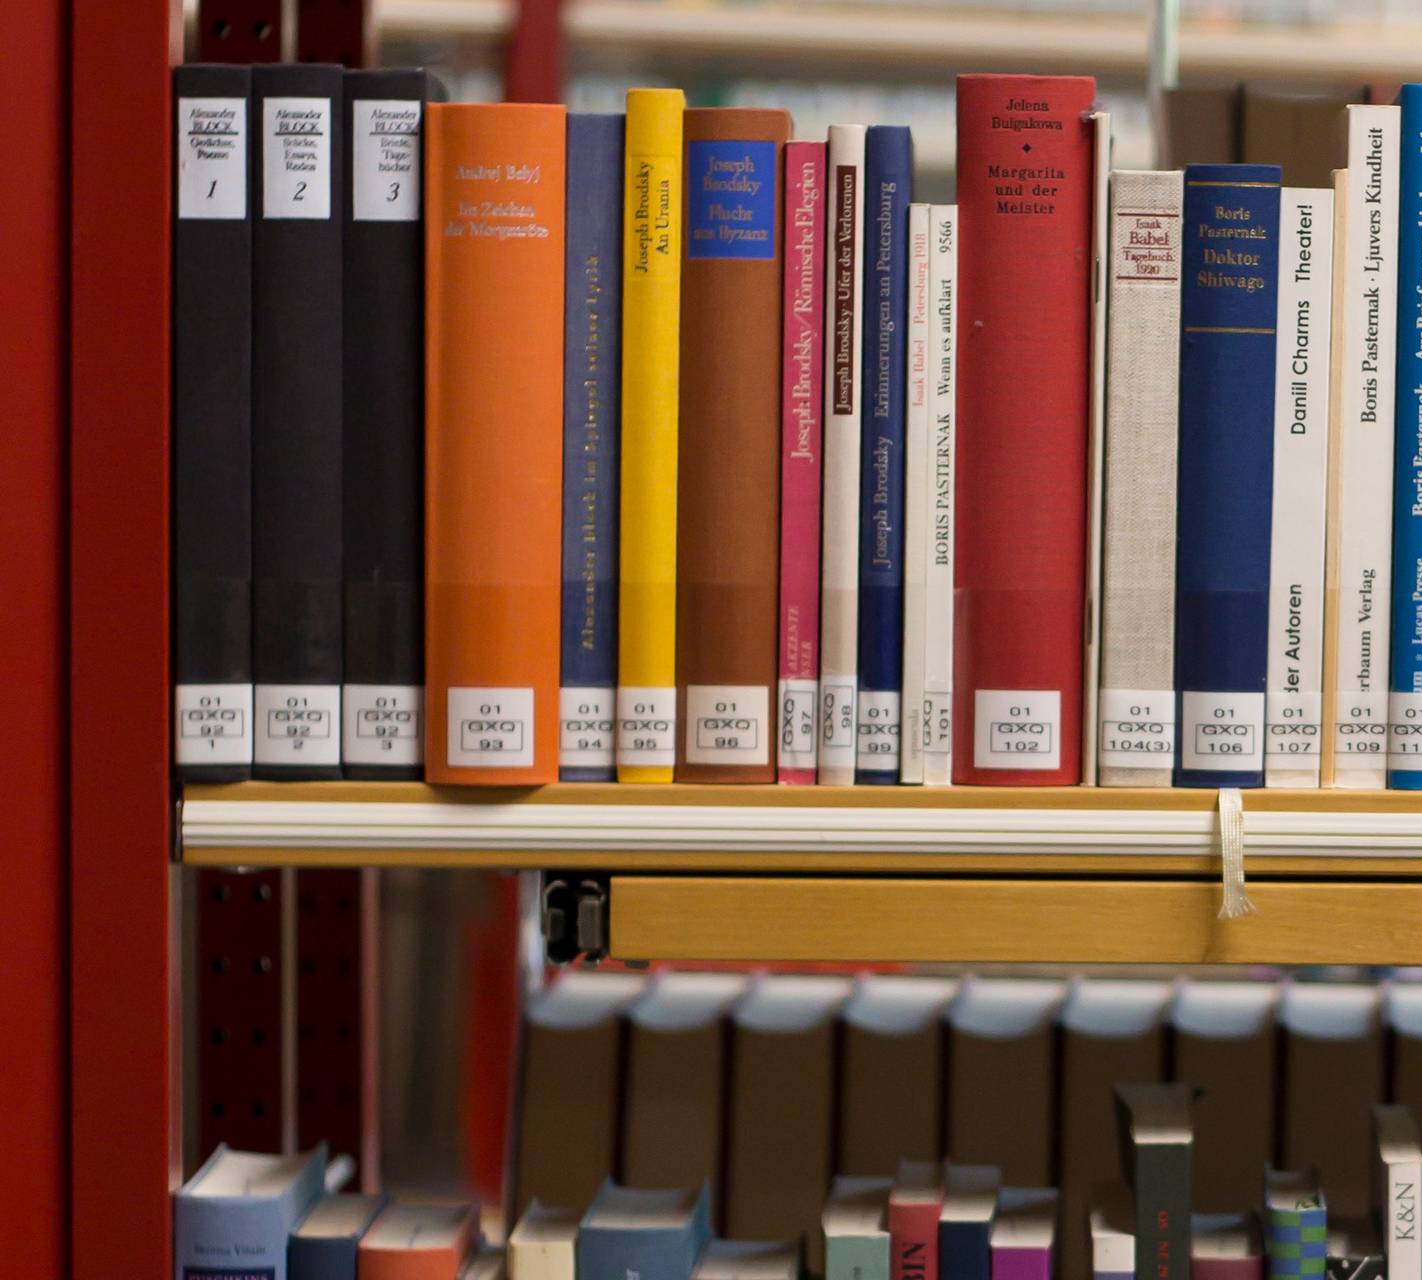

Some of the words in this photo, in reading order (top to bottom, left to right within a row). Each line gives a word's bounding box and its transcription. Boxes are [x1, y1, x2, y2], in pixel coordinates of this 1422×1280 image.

[1006, 99, 1049, 112] Jelena
[991, 117, 1063, 131] Bulgakowa
[707, 156, 754, 175] Joseph
[988, 165, 1065, 182] Margarita
[1365, 128, 1382, 204] Kindheit
[293, 182, 306, 201] 2
[386, 182, 400, 202] 3
[635, 161, 655, 220] Brodsky
[703, 176, 760, 196] Brodsky
[795, 162, 818, 227] Elegien
[995, 184, 1026, 197] und
[1032, 184, 1057, 197] der
[656, 180, 669, 229] Urania
[839, 174, 852, 242] Verlorenen
[996, 201, 1055, 215] Meister
[1215, 206, 1250, 220] Boris
[876, 182, 896, 271] Petersburg
[939, 221, 953, 253] 9566
[1129, 231, 1170, 246] Babel
[1136, 218, 1161, 230] Isaak
[1199, 224, 1267, 239] Pasternak
[635, 223, 653, 273] Joseph
[656, 234, 669, 255] An
[838, 246, 851, 267] der
[1295, 205, 1312, 283] Theater!
[1364, 209, 1384, 273] Ljuvers
[1203, 249, 1260, 266] Doktor
[838, 269, 851, 300] Ufer
[878, 276, 890, 297] an
[1197, 271, 1264, 292] Shiwago
[837, 308, 852, 363] Brodsky
[1292, 300, 1309, 375] Charms
[1361, 288, 1379, 373] Pasternak
[875, 302, 895, 418] Erinnerungen
[836, 367, 851, 410] Joseph
[937, 357, 951, 396] Wenn
[1290, 382, 1307, 435] Daniil
[1361, 378, 1377, 424] Boris
[792, 401, 815, 463] Joseph
[874, 436, 893, 504] Brodsky
[935, 414, 951, 509] PASTERNAK
[874, 510, 892, 568] Joseph
[935, 514, 949, 565] BORIS
[1358, 569, 1375, 623] Verlag
[1284, 584, 1301, 661] Autoren
[479, 738, 503, 750] 93
[633, 738, 658, 750] 95
[714, 737, 739, 749] 96
[1003, 740, 1040, 752] 102
[1109, 740, 1171, 754] 104(3)
[1207, 743, 1243, 754] 106
[1276, 742, 1312, 753] 107
[1345, 741, 1380, 753] 109
[1396, 1182, 1414, 1240] K&N
